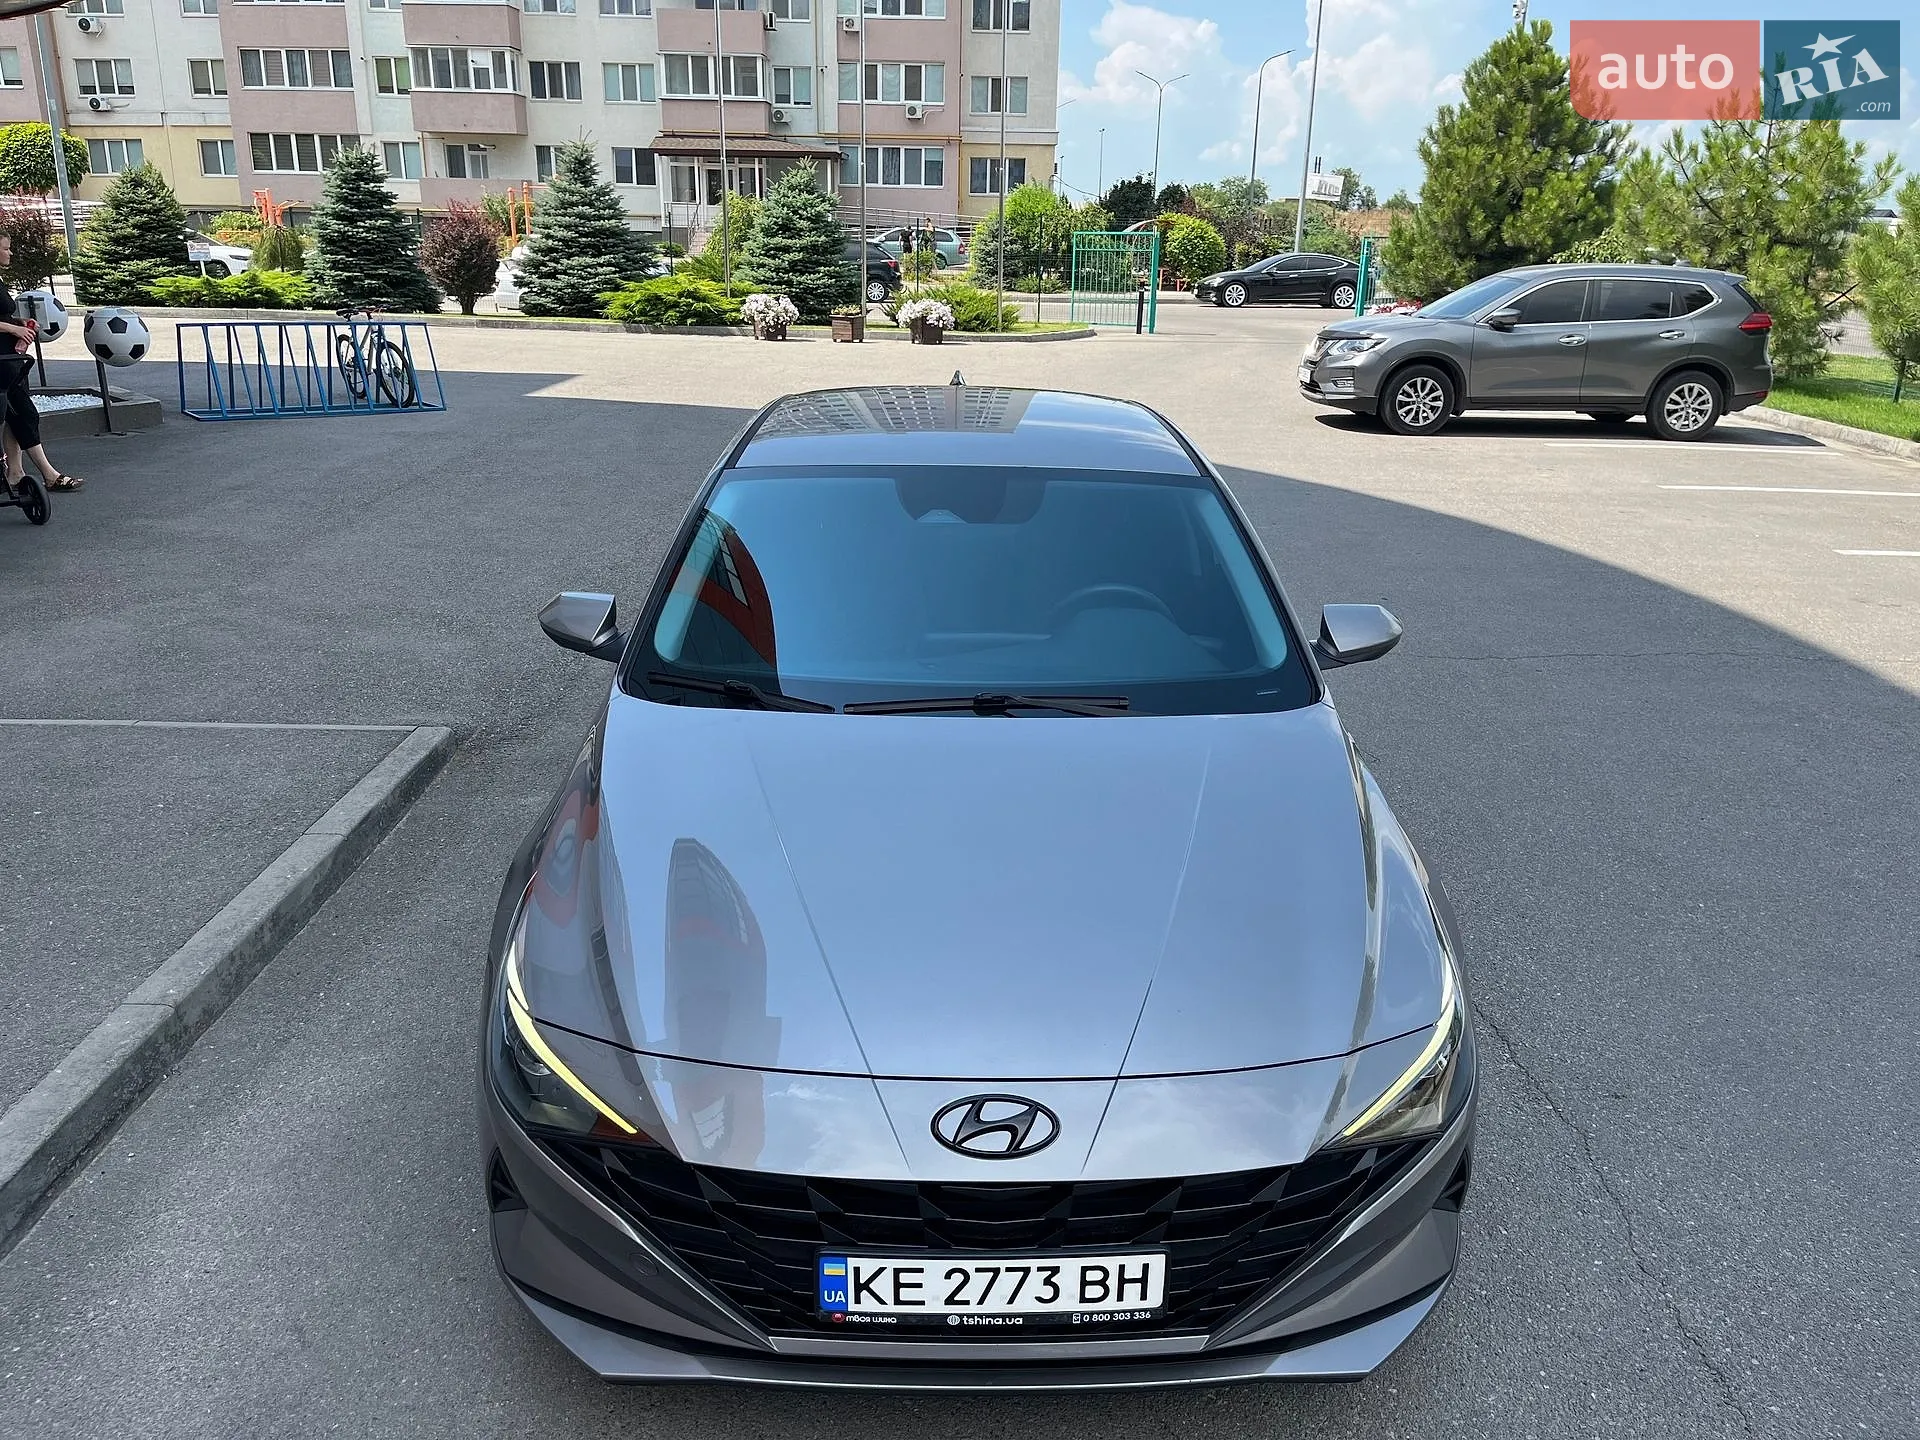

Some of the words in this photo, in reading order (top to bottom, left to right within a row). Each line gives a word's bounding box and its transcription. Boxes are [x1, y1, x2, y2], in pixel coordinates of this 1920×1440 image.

[853, 1265, 926, 1306] KE
[944, 1266, 1060, 1306] 2773
[1079, 1263, 1149, 1304] BH
[824, 1290, 846, 1303] UA
[872, 1316, 897, 1324] шина
[963, 1315, 1023, 1325] tshina.ua
[1083, 1314, 1090, 1322] 0
[1092, 1313, 1110, 1322] 800
[1112, 1312, 1131, 1321] 303
[1133, 1311, 1151, 1319] 336
